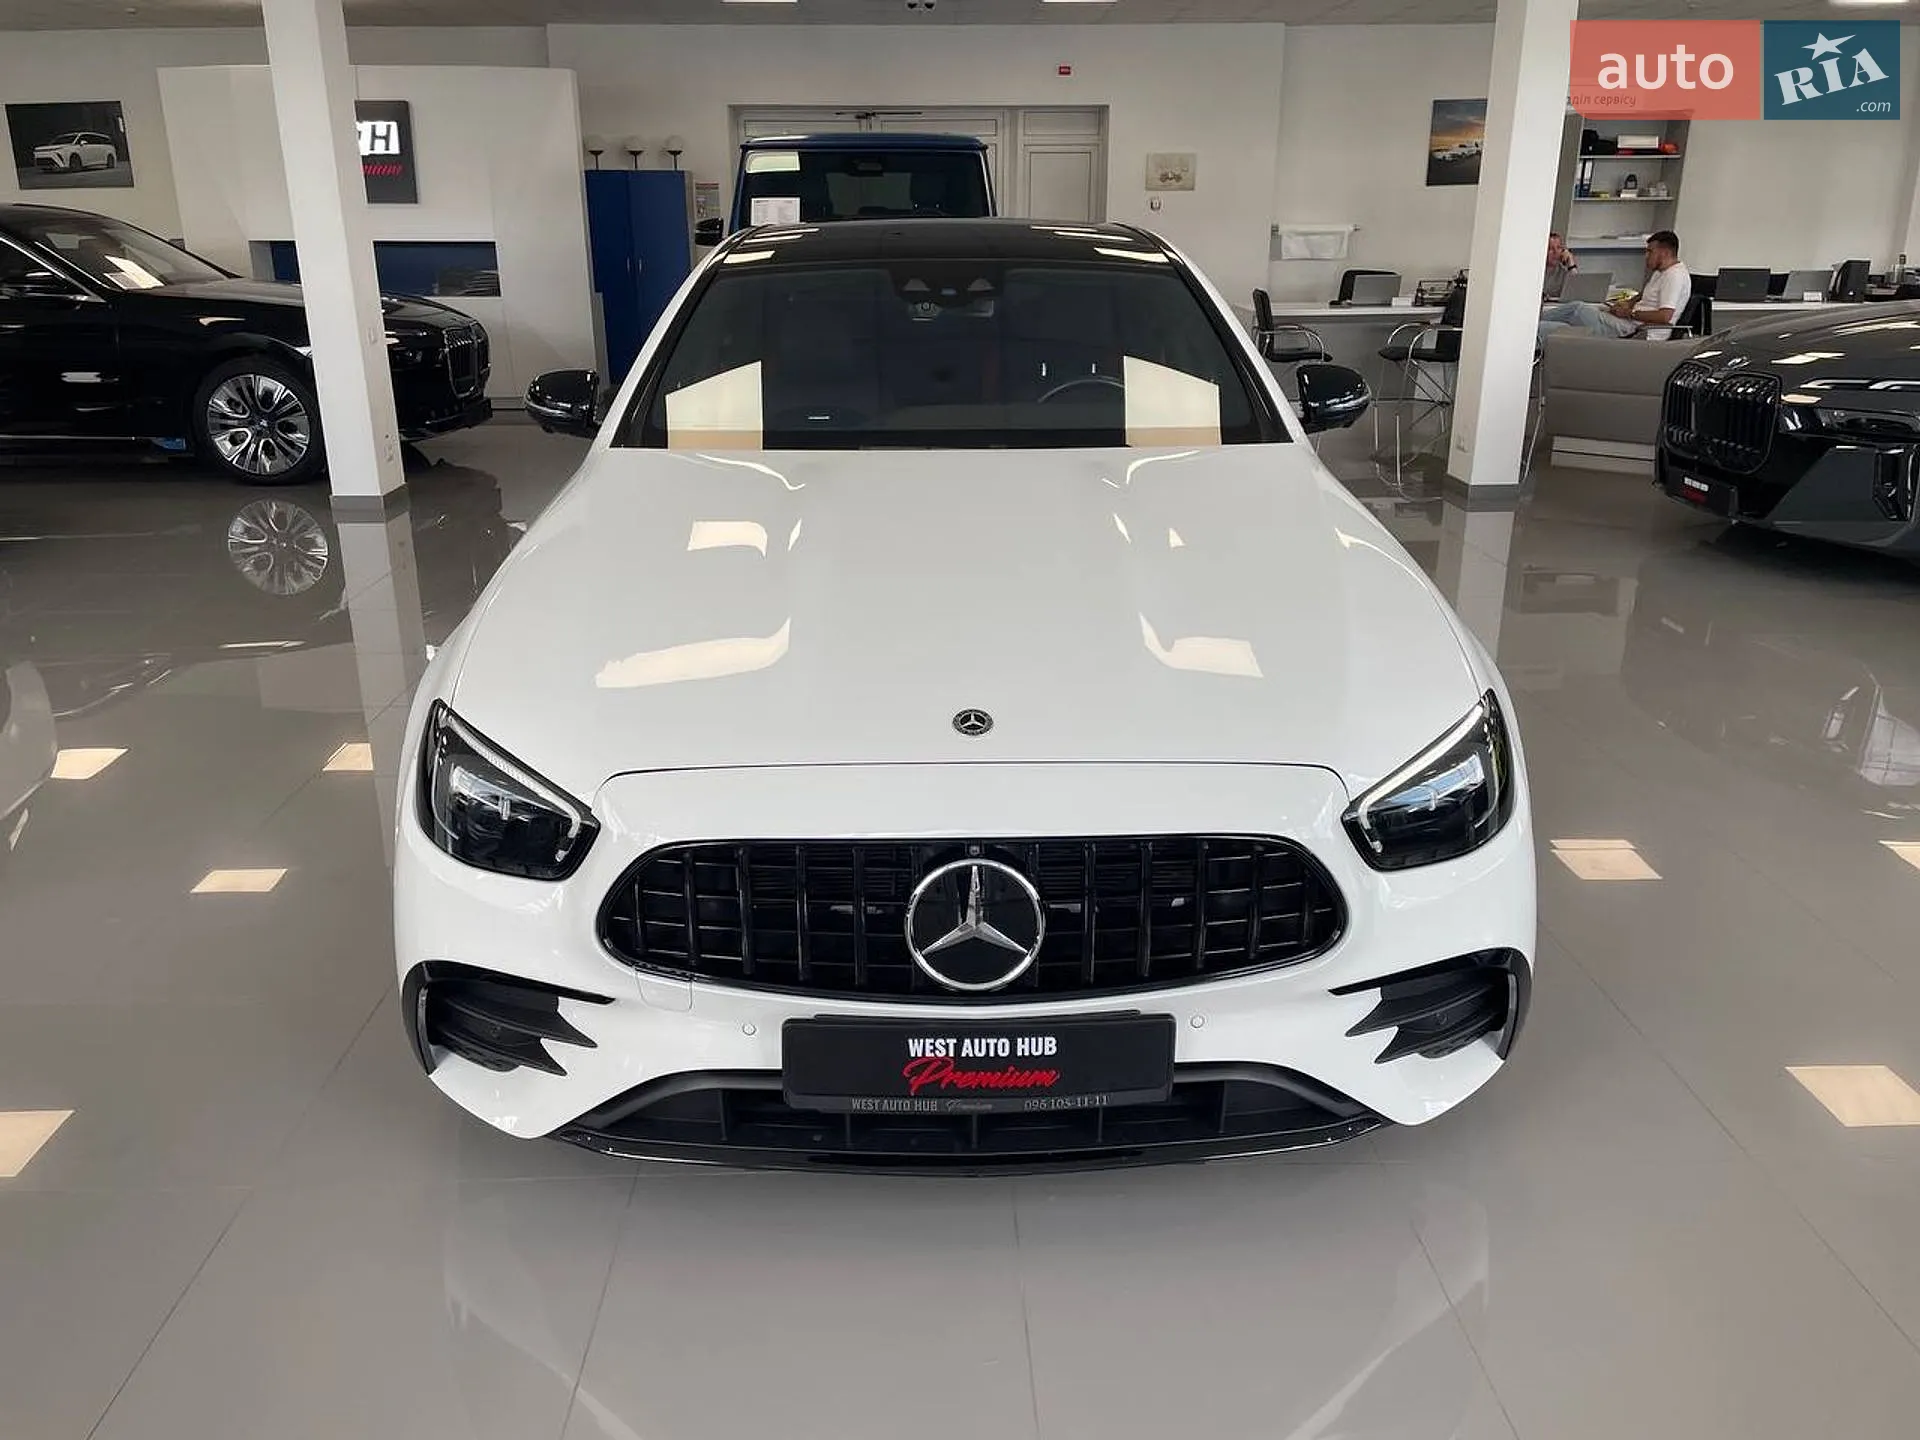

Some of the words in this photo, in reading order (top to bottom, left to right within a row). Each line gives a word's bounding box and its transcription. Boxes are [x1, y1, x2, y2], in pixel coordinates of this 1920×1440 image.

[358, 123, 391, 151] H
[908, 1038, 956, 1057] WEST
[961, 1038, 1010, 1057] AUTO
[1016, 1037, 1057, 1056] HUB
[903, 1056, 1060, 1096] Premium
[852, 1098, 879, 1111] WEST
[881, 1098, 911, 1112] AUTO
[914, 1098, 937, 1112] HUB
